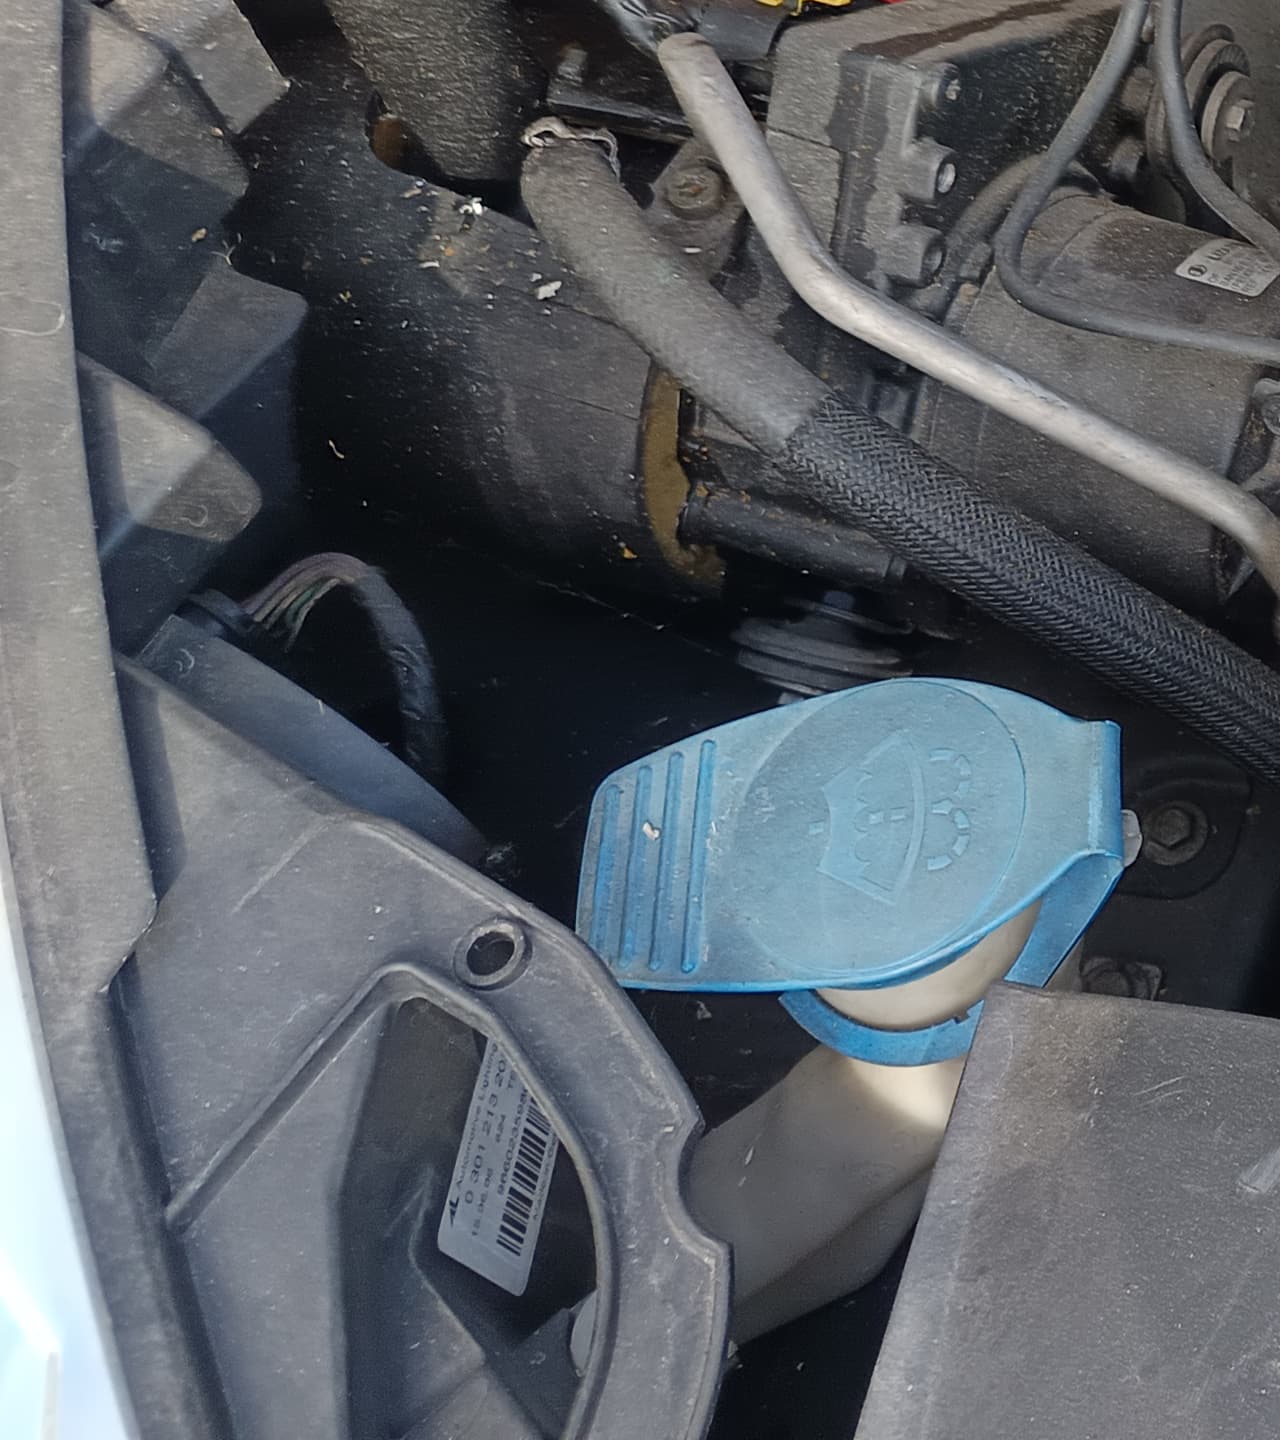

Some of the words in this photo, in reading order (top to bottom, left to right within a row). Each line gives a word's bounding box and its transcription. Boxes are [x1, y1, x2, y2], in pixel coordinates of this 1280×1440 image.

[463, 1190, 474, 1204] 0
[470, 1143, 486, 1184] 301
[482, 1093, 498, 1137] 213
[494, 1053, 507, 1088] 20
